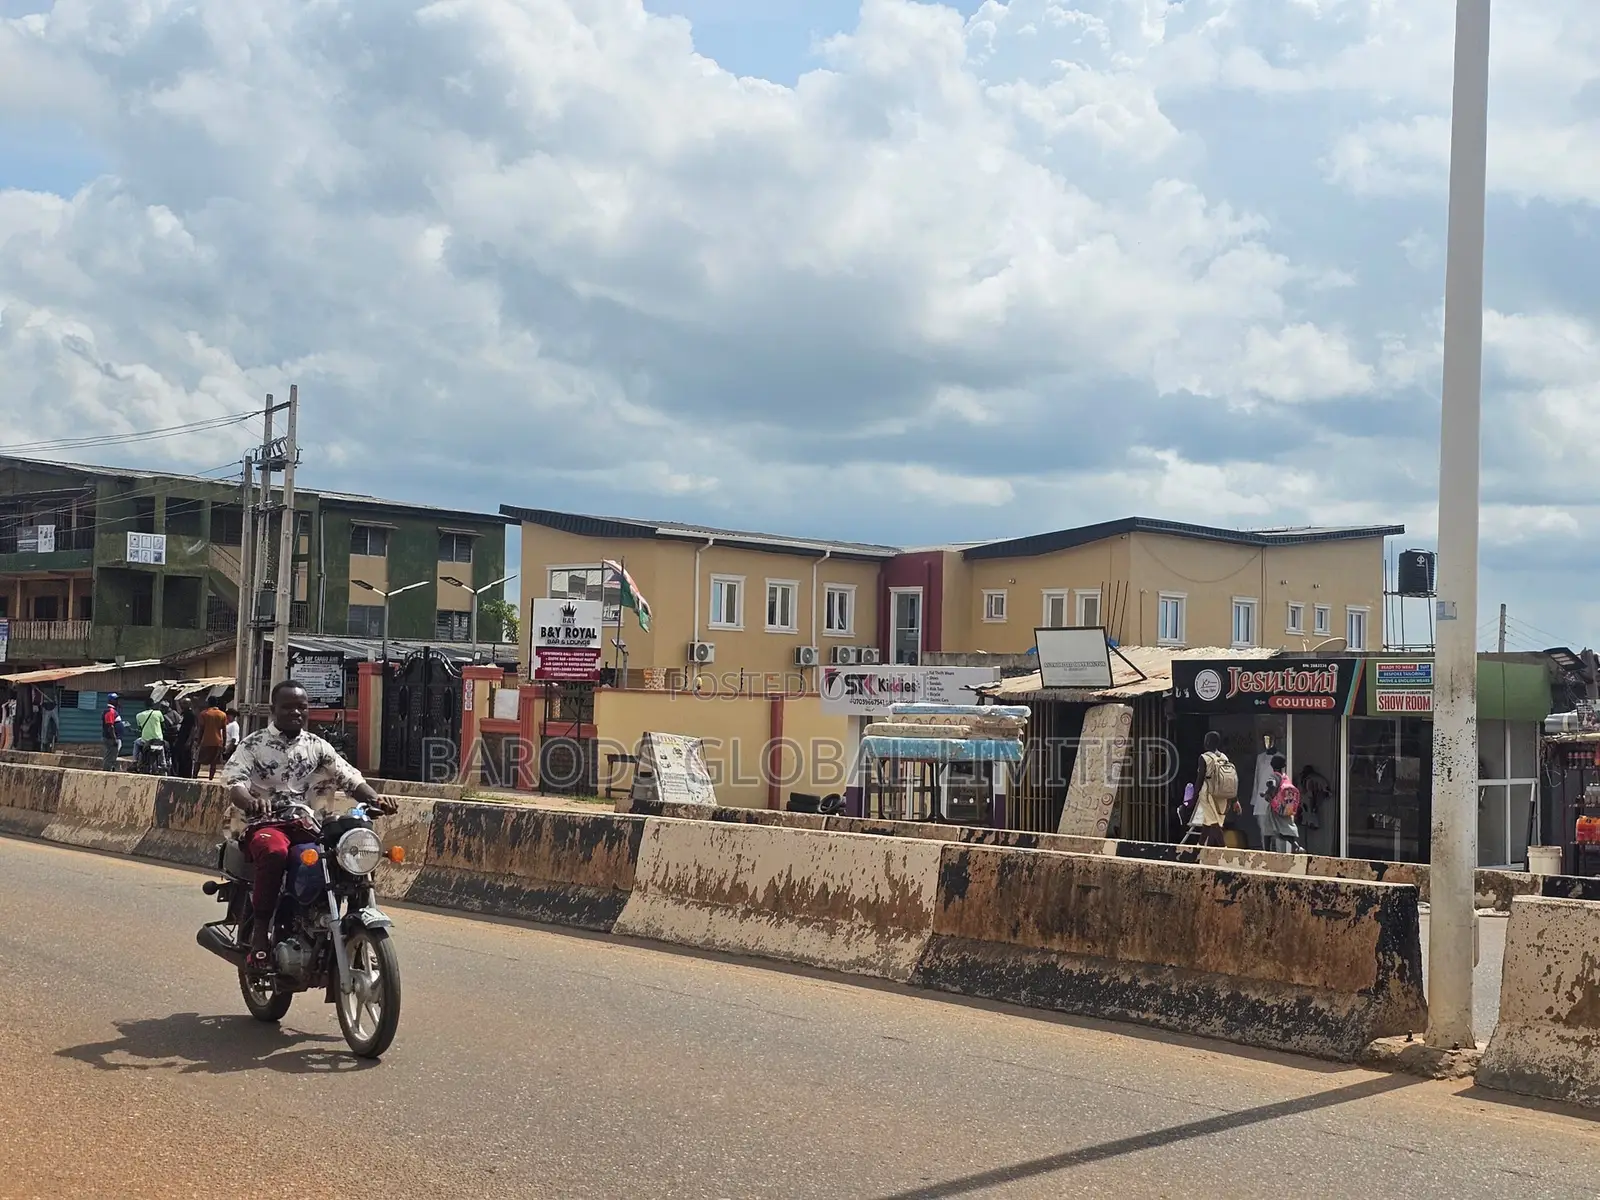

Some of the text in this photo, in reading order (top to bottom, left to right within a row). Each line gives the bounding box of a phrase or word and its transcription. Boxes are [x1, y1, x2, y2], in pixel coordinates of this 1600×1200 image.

[540, 626, 597, 639] B&Y ROYAL
[844, 674, 916, 696] STK Kiddies
[1226, 664, 1338, 698] Jesutoni
[1276, 698, 1328, 708] COUTURE
[1378, 696, 1430, 710] SHOW ROOM
